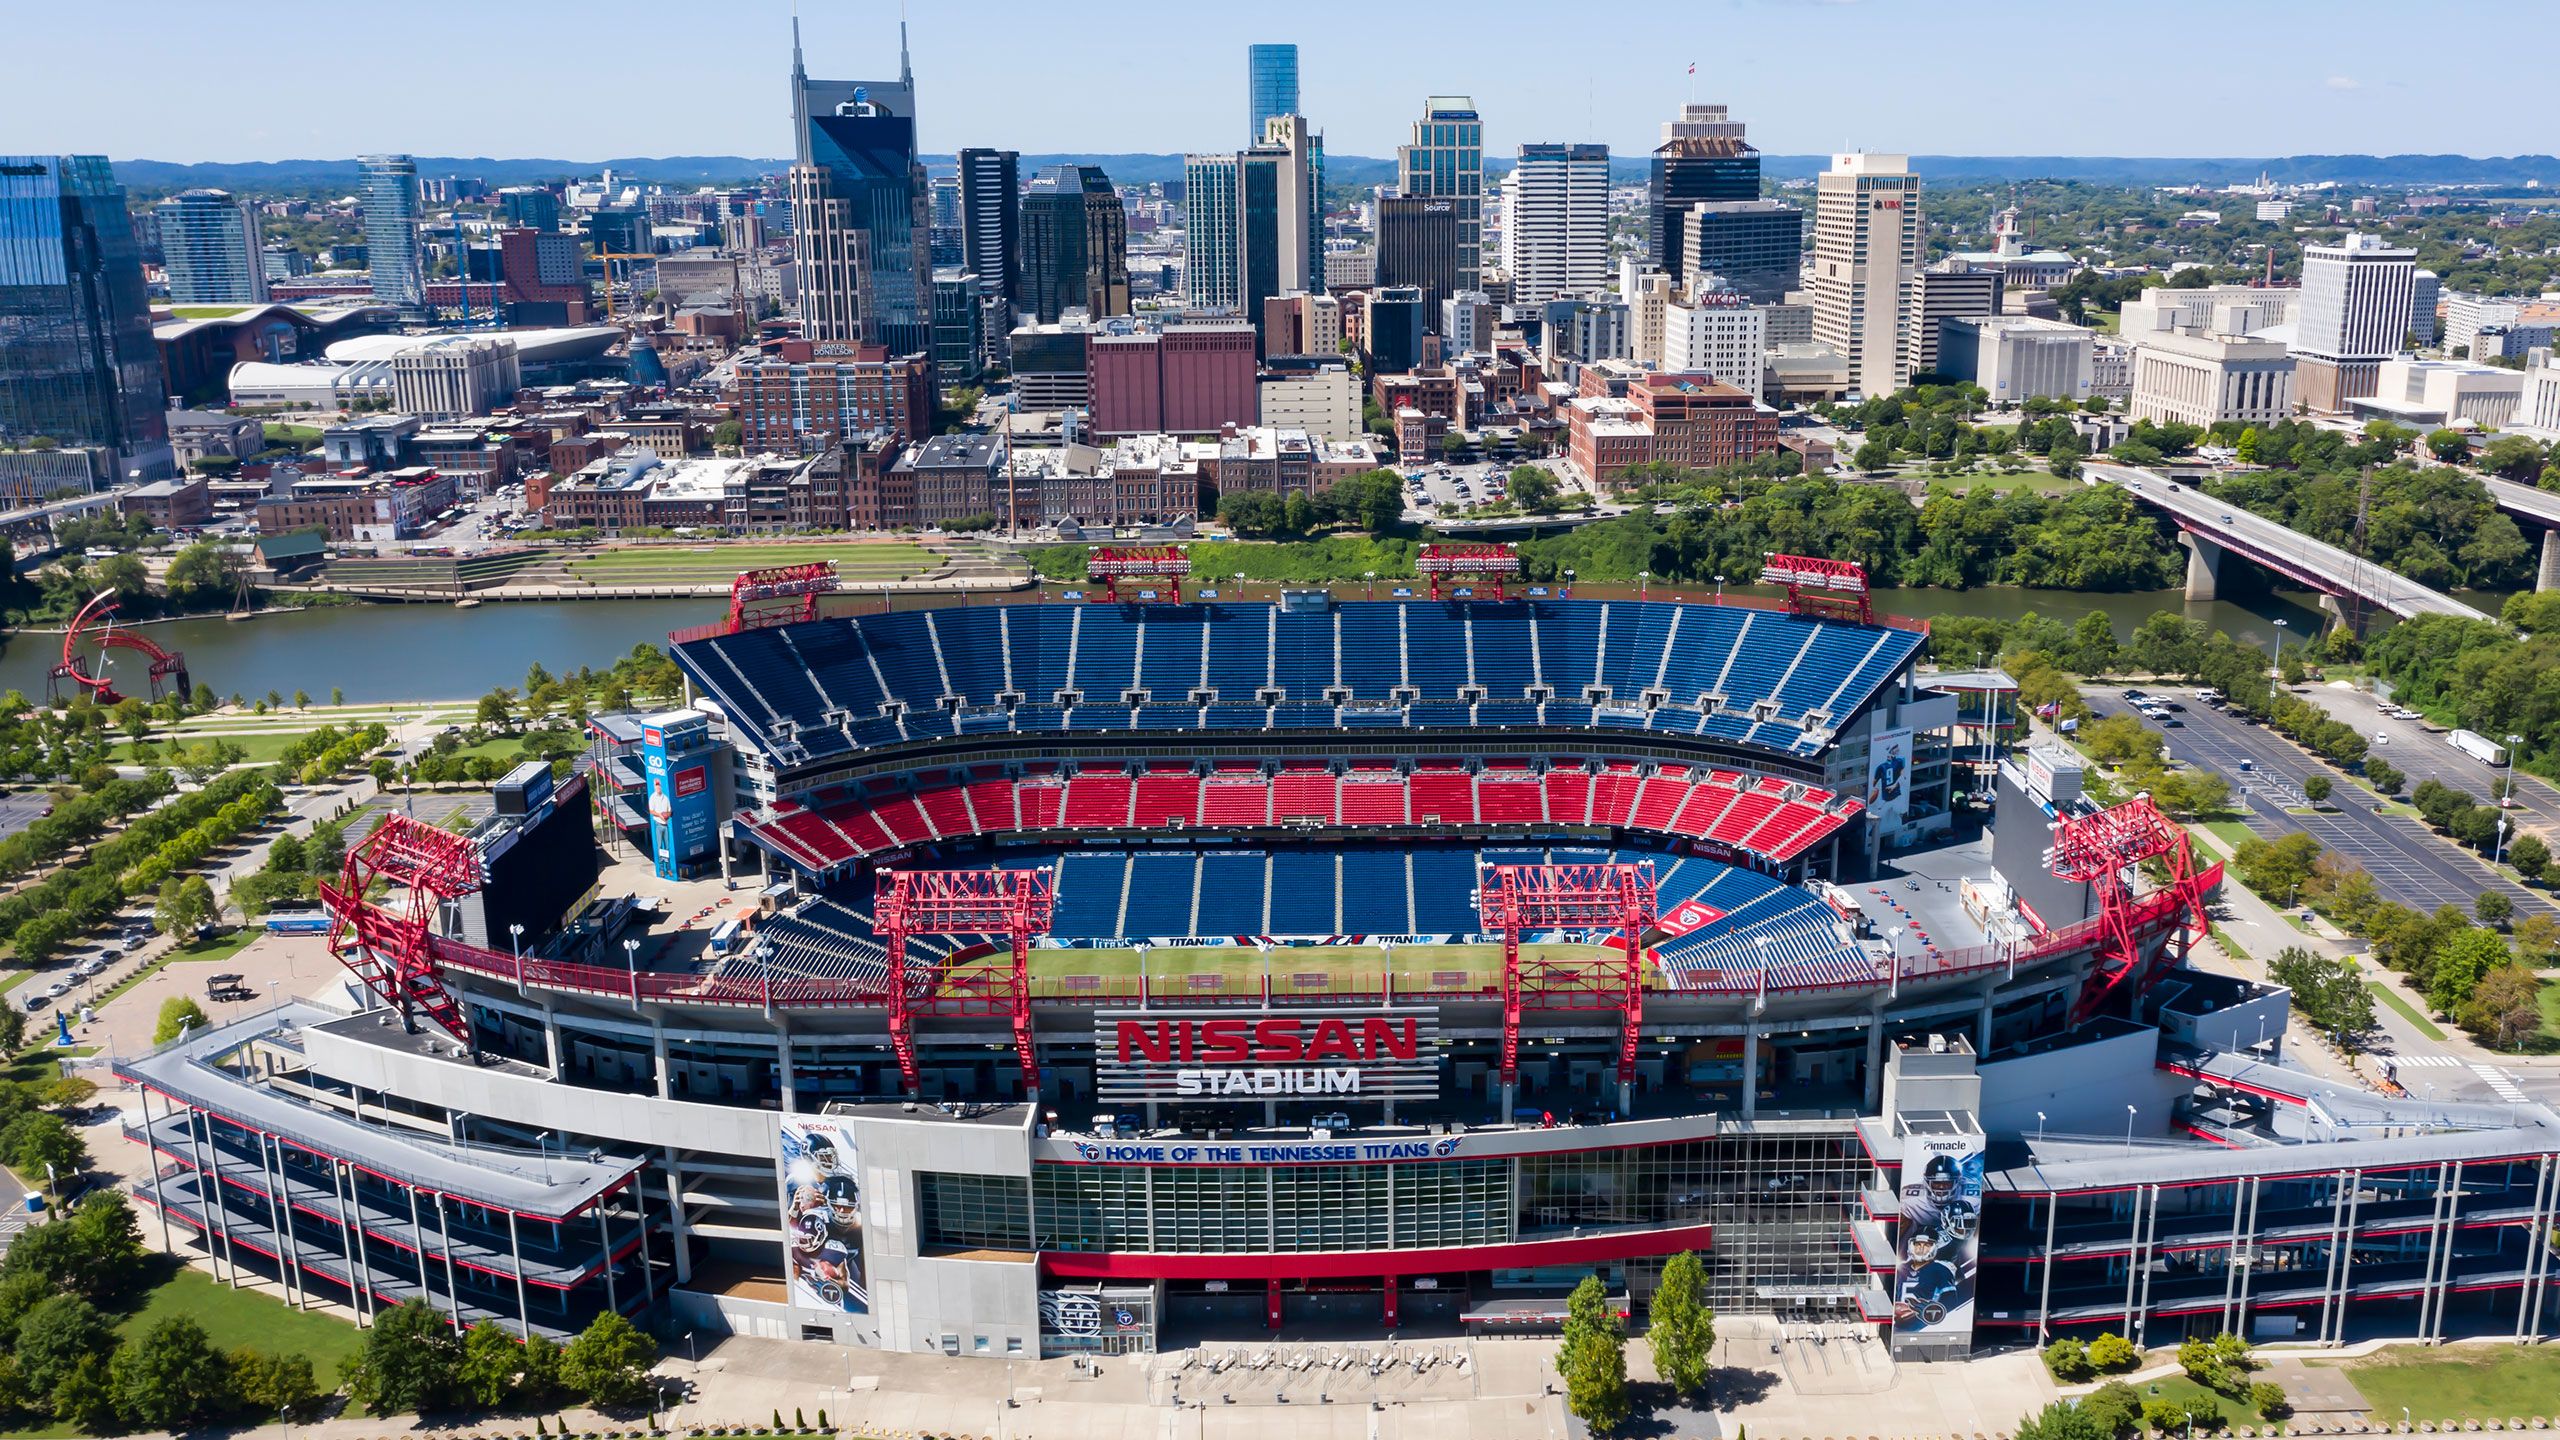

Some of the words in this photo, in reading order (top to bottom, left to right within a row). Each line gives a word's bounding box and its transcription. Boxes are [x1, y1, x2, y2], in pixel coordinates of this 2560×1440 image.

[1424, 204, 1451, 212] Source
[1884, 200, 1901, 209] UBS
[648, 755, 663, 768] GO
[1886, 767, 1894, 786] 9
[1693, 843, 1732, 857] NISSAN
[873, 851, 912, 866] NISSAN
[1117, 1018, 1417, 1063] NISSAN
[1176, 1069, 1360, 1096] STADIUM
[797, 1122, 837, 1133] NISSAN
[1106, 1145, 1164, 1161] HOME
[1171, 1146, 1198, 1161] OF
[1205, 1147, 1242, 1162] THE
[1248, 1145, 1356, 1162] TENNESSEE
[1363, 1143, 1430, 1159] TITANS
[1923, 1140, 1967, 1151] Pinnacle
